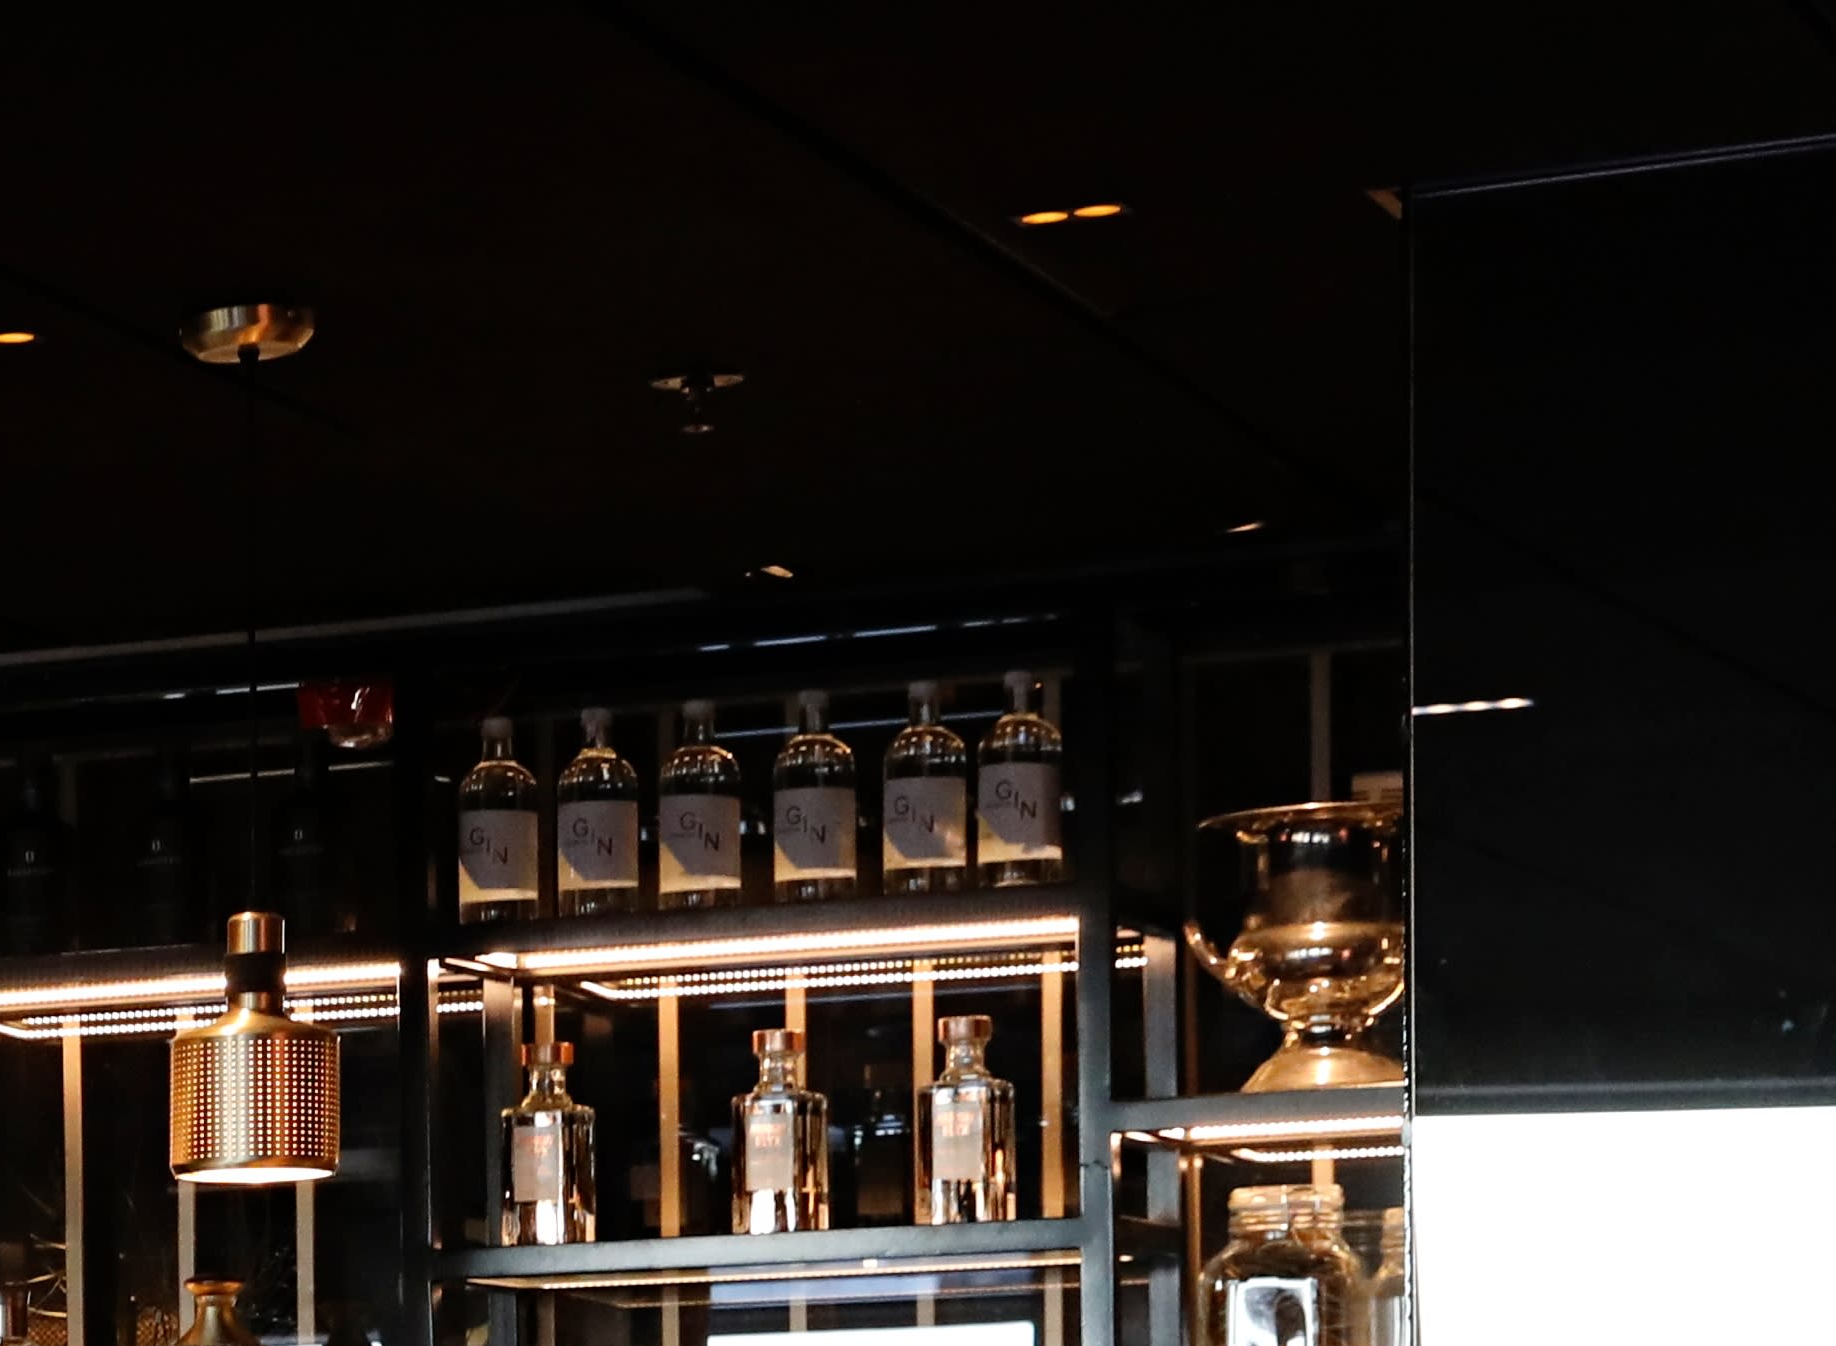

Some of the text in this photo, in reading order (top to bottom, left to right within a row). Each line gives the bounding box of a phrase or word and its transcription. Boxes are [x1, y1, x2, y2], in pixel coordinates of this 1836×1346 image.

[894, 795, 935, 834] GIN
[994, 779, 1038, 820] GIN
[572, 817, 612, 857] GIN
[679, 811, 720, 851] GIN
[786, 806, 826, 844] GIN
[469, 827, 508, 865] GIN
